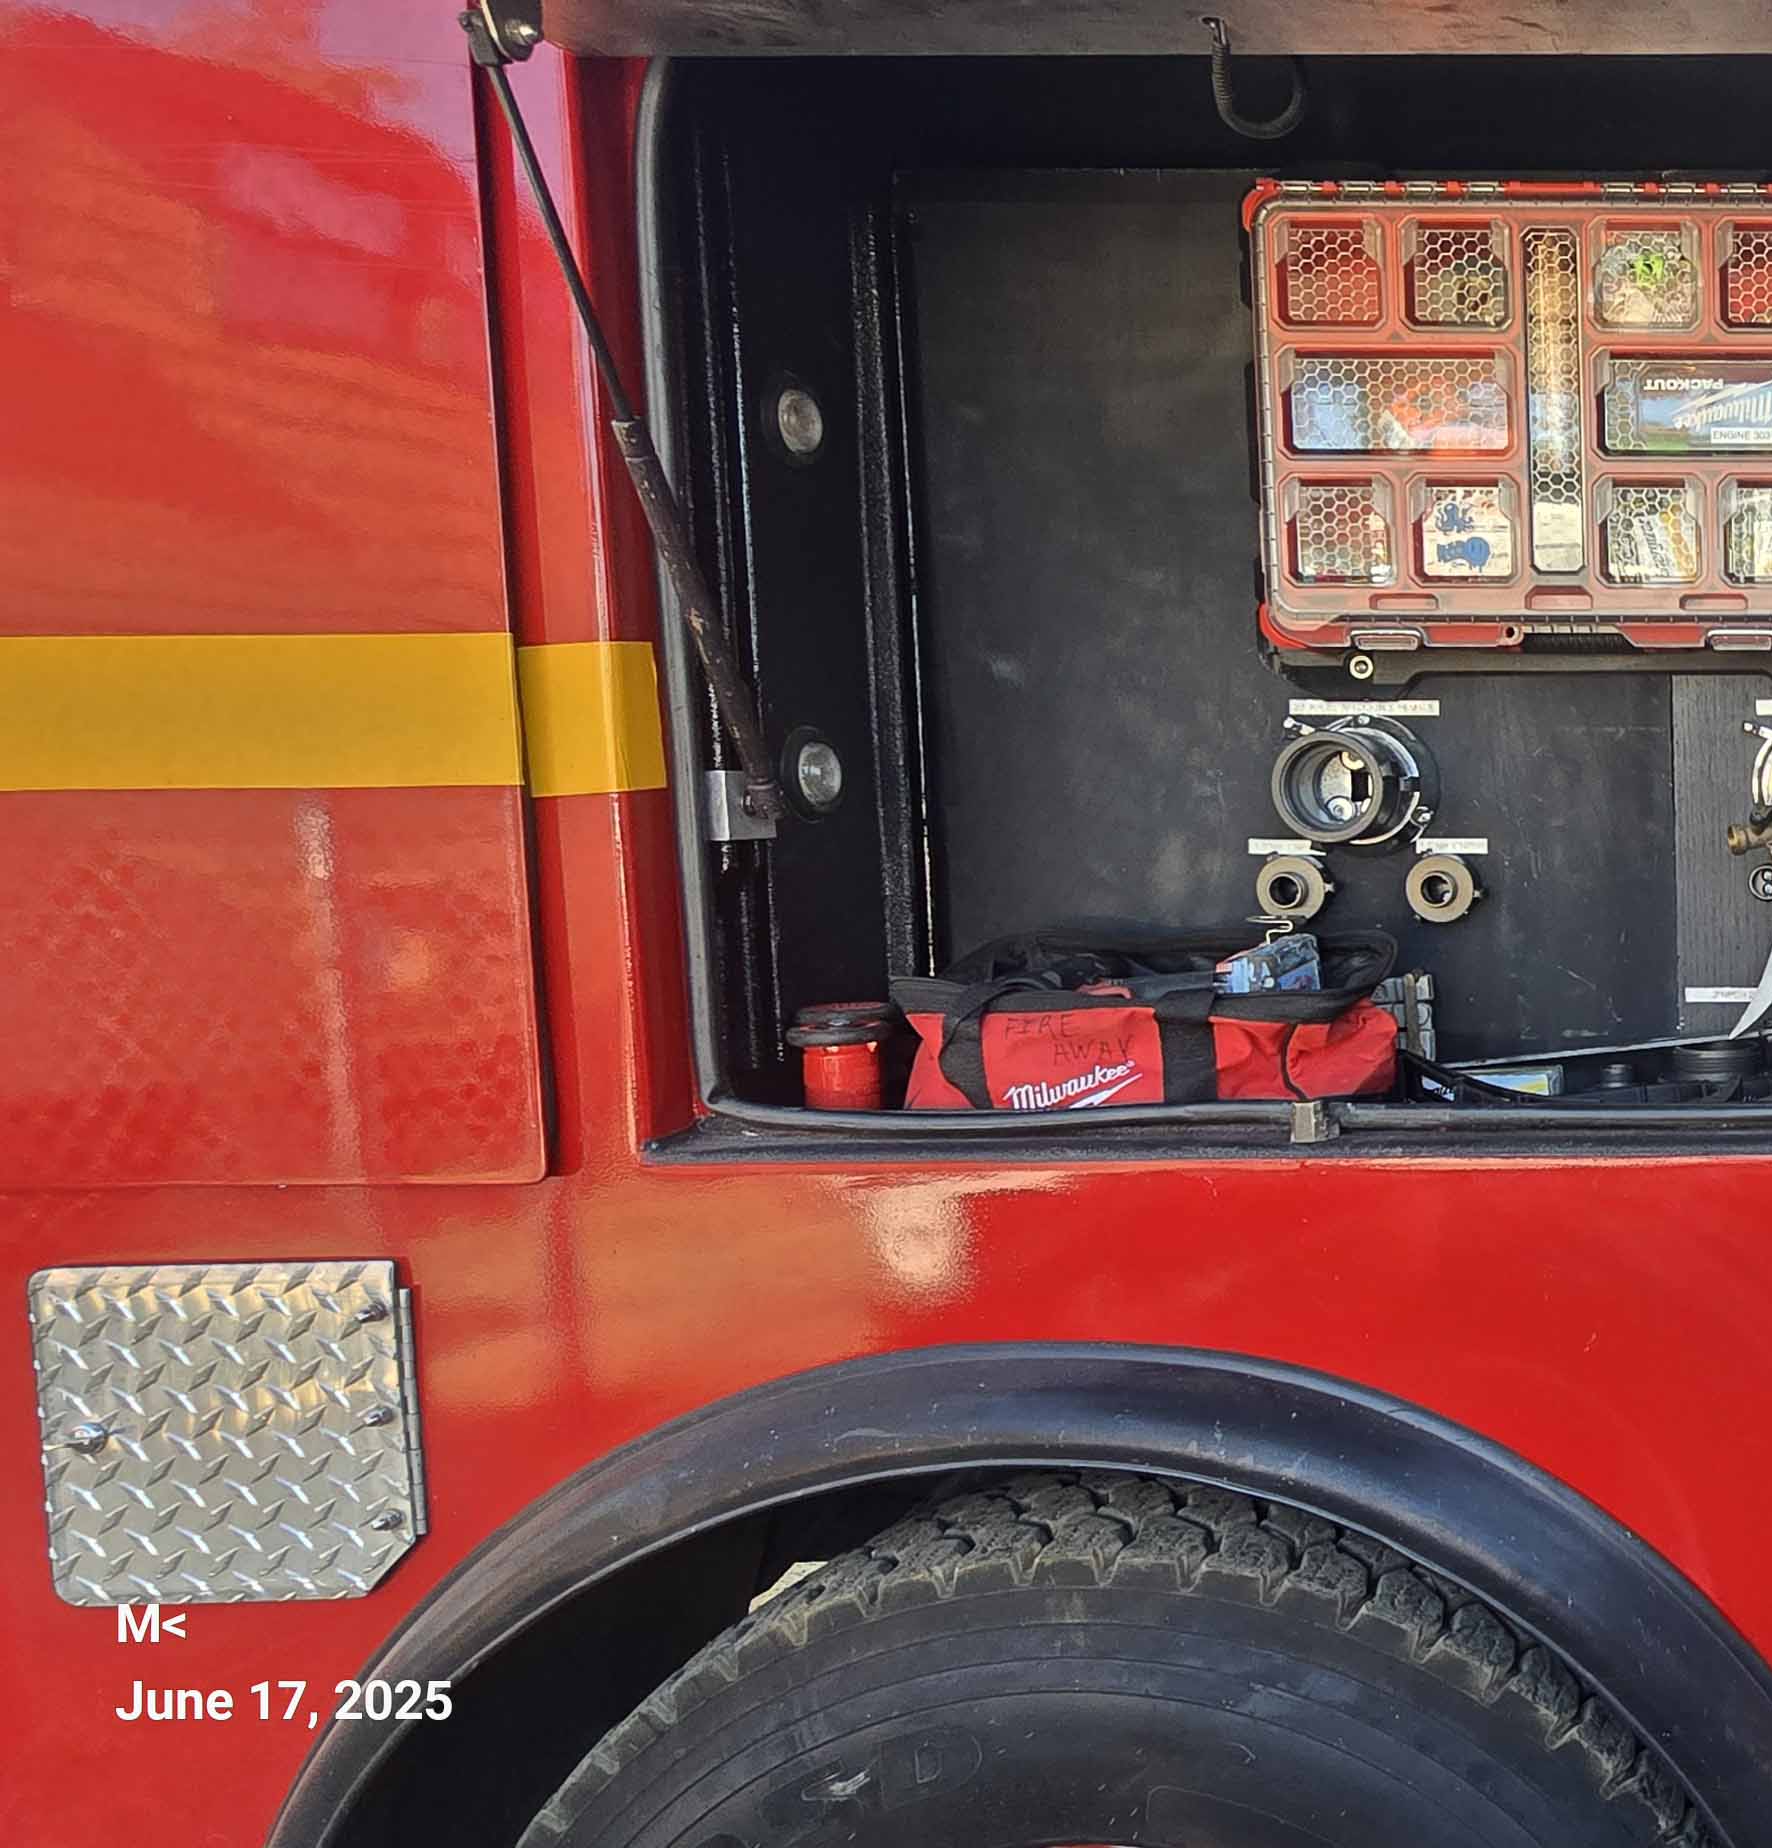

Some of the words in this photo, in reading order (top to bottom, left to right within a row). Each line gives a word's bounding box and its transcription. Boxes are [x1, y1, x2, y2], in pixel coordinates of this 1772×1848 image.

[1643, 378, 1724, 392] PACKOUT
[1712, 428, 1752, 441] ENGINE
[1004, 1014, 1077, 1040] FIRE
[1053, 1034, 1135, 1066] AWAY
[1002, 1062, 1131, 1110] Milwaukee
